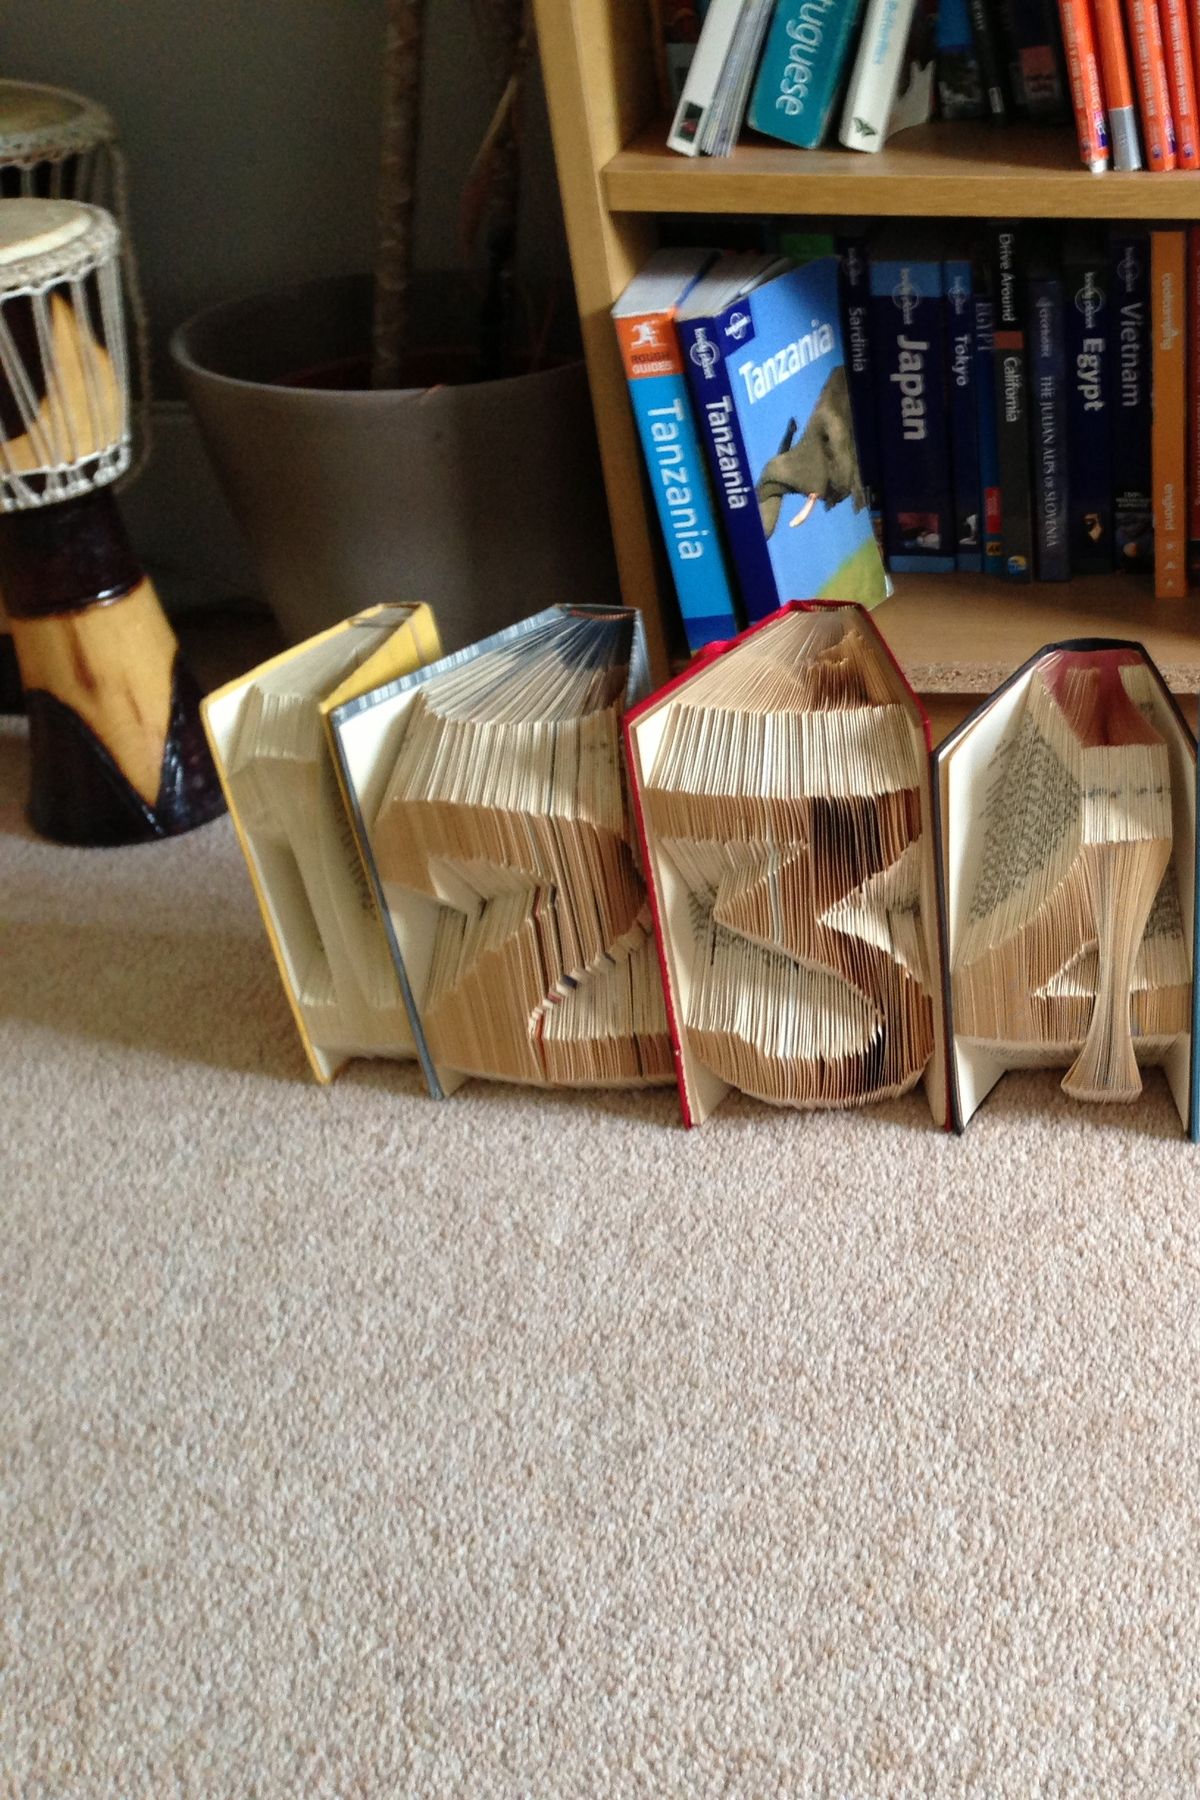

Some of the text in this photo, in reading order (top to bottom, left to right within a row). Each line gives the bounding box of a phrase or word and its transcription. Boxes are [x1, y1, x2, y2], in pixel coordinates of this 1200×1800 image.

[999, 233, 1017, 322] Drive Around
[739, 318, 835, 405] Tanzania
[849, 307, 869, 373] Sardinia
[952, 334, 972, 387] Tokyo
[1119, 303, 1143, 407] Vietnam
[890, 334, 931, 441] Japan
[1003, 356, 1023, 423] California
[1039, 375, 1055, 400] THE
[1077, 337, 1106, 412] Egypt
[705, 395, 750, 511] Tanzania
[1040, 401, 1056, 445] JULIAN
[647, 397, 709, 561] Tanzania
[1042, 447, 1057, 475] ALPS
[1044, 490, 1059, 548] SLOVENIA
[1162, 483, 1177, 531] england
